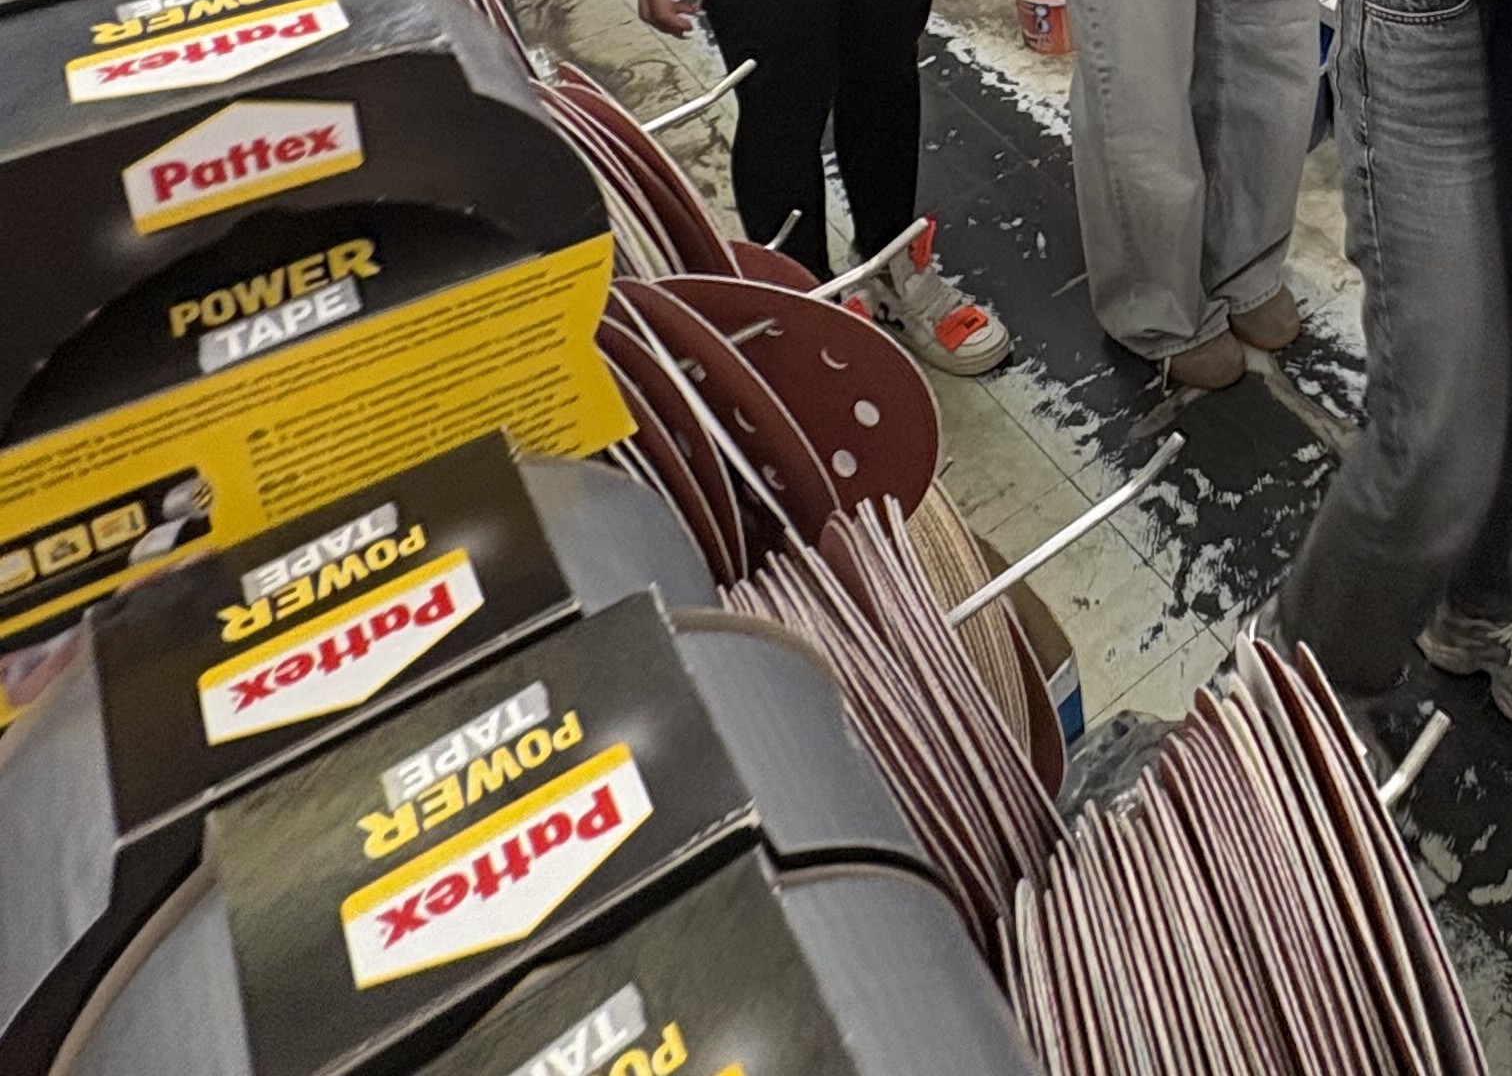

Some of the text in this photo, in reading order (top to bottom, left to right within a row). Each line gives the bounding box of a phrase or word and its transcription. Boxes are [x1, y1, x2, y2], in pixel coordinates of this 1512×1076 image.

[97, 13, 322, 84] Pattex
[150, 124, 342, 204] Pattex
[169, 237, 382, 338] POWER
[209, 283, 354, 364] TAPE
[218, 522, 427, 642] POWER
[258, 511, 396, 591] TAPE
[228, 580, 458, 713] Pattex
[356, 709, 585, 860] POWER
[398, 697, 538, 792] TAPE
[376, 781, 626, 949] Pattex
